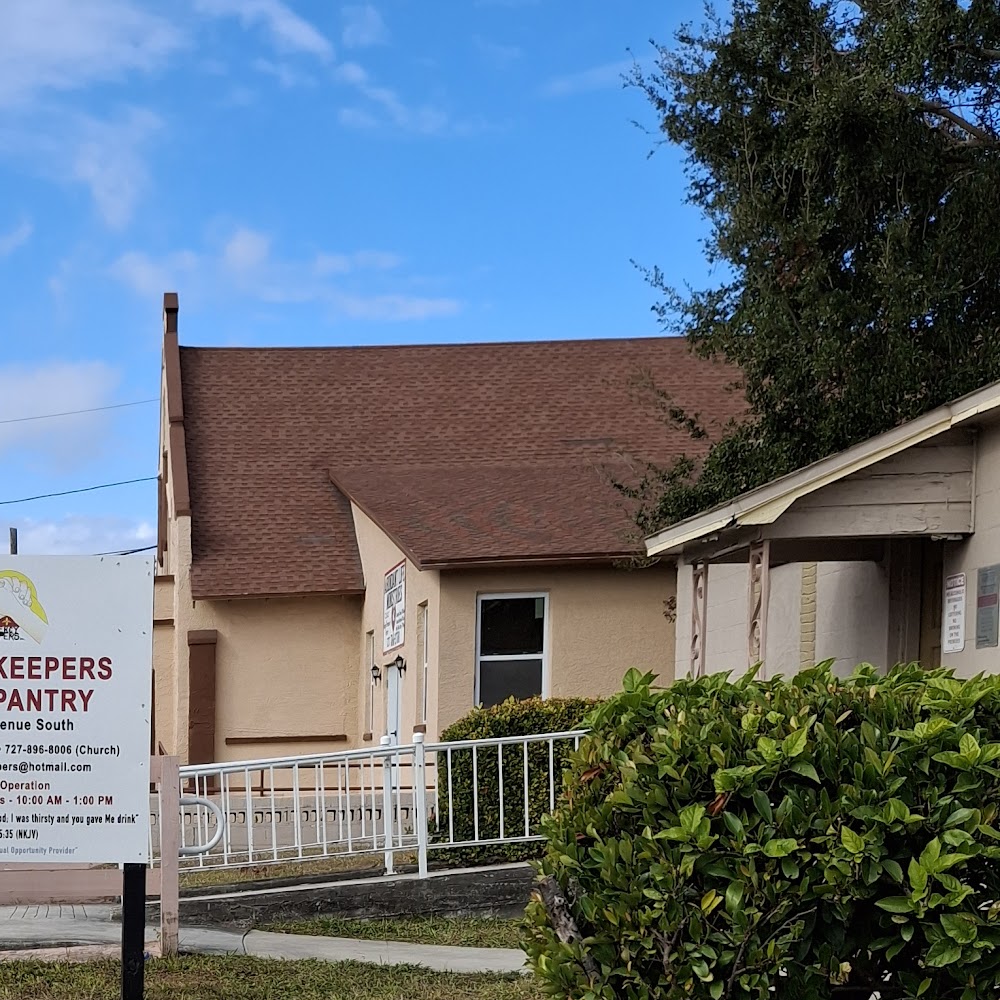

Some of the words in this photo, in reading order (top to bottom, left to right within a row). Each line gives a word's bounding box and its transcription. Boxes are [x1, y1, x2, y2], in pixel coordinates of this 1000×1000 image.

[36, 718, 73, 731] South
[5, 744, 71, 754] 727-896-8006
[76, 745, 120, 757] (Church)
[0, 780, 50, 792] Operation
[17, 795, 43, 805] 10:00
[47, 795, 62, 805] AM
[74, 795, 94, 805] 1:00
[98, 796, 113, 805] PM
[32, 813, 54, 825] thirsty
[57, 814, 69, 823] and
[72, 816, 84, 825] you
[86, 816, 102, 826] gave
[105, 814, 115, 823] Me
